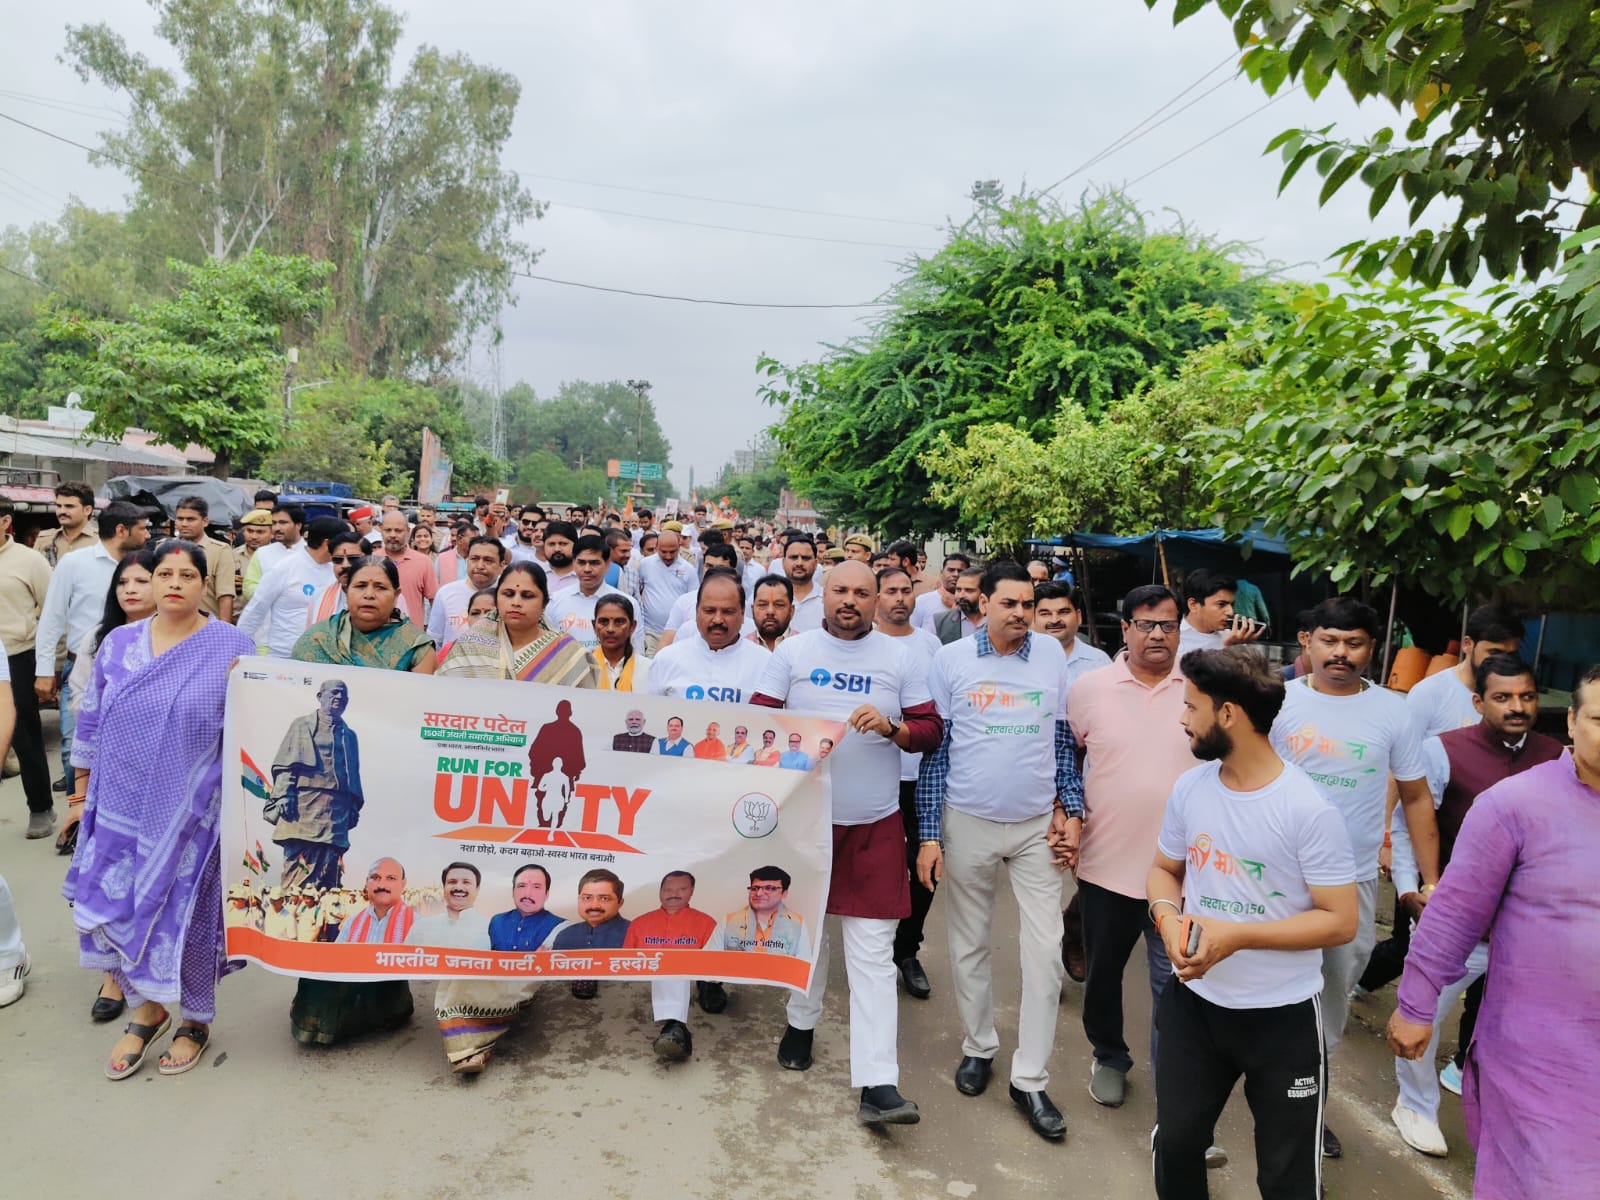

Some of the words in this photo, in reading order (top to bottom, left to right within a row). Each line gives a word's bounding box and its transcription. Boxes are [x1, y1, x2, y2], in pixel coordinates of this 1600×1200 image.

[832, 672, 872, 695] SBI
[707, 687, 741, 703] SBI
[424, 712, 480, 730] सरदार
[483, 713, 527, 733] पटेल
[437, 756, 479, 774] RUN
[484, 760, 523, 777] FOR
[460, 843, 477, 853] नशा
[499, 846, 518, 856] कदम
[569, 851, 587, 861] भारत
[1199, 895, 1265, 915] सरदार@150
[376, 948, 440, 968] भारतीय
[445, 954, 493, 971] जनता
[498, 951, 543, 974] पार्टी,
[609, 952, 664, 972] हरदोई
[1294, 1076, 1316, 1087] ACTIVE
